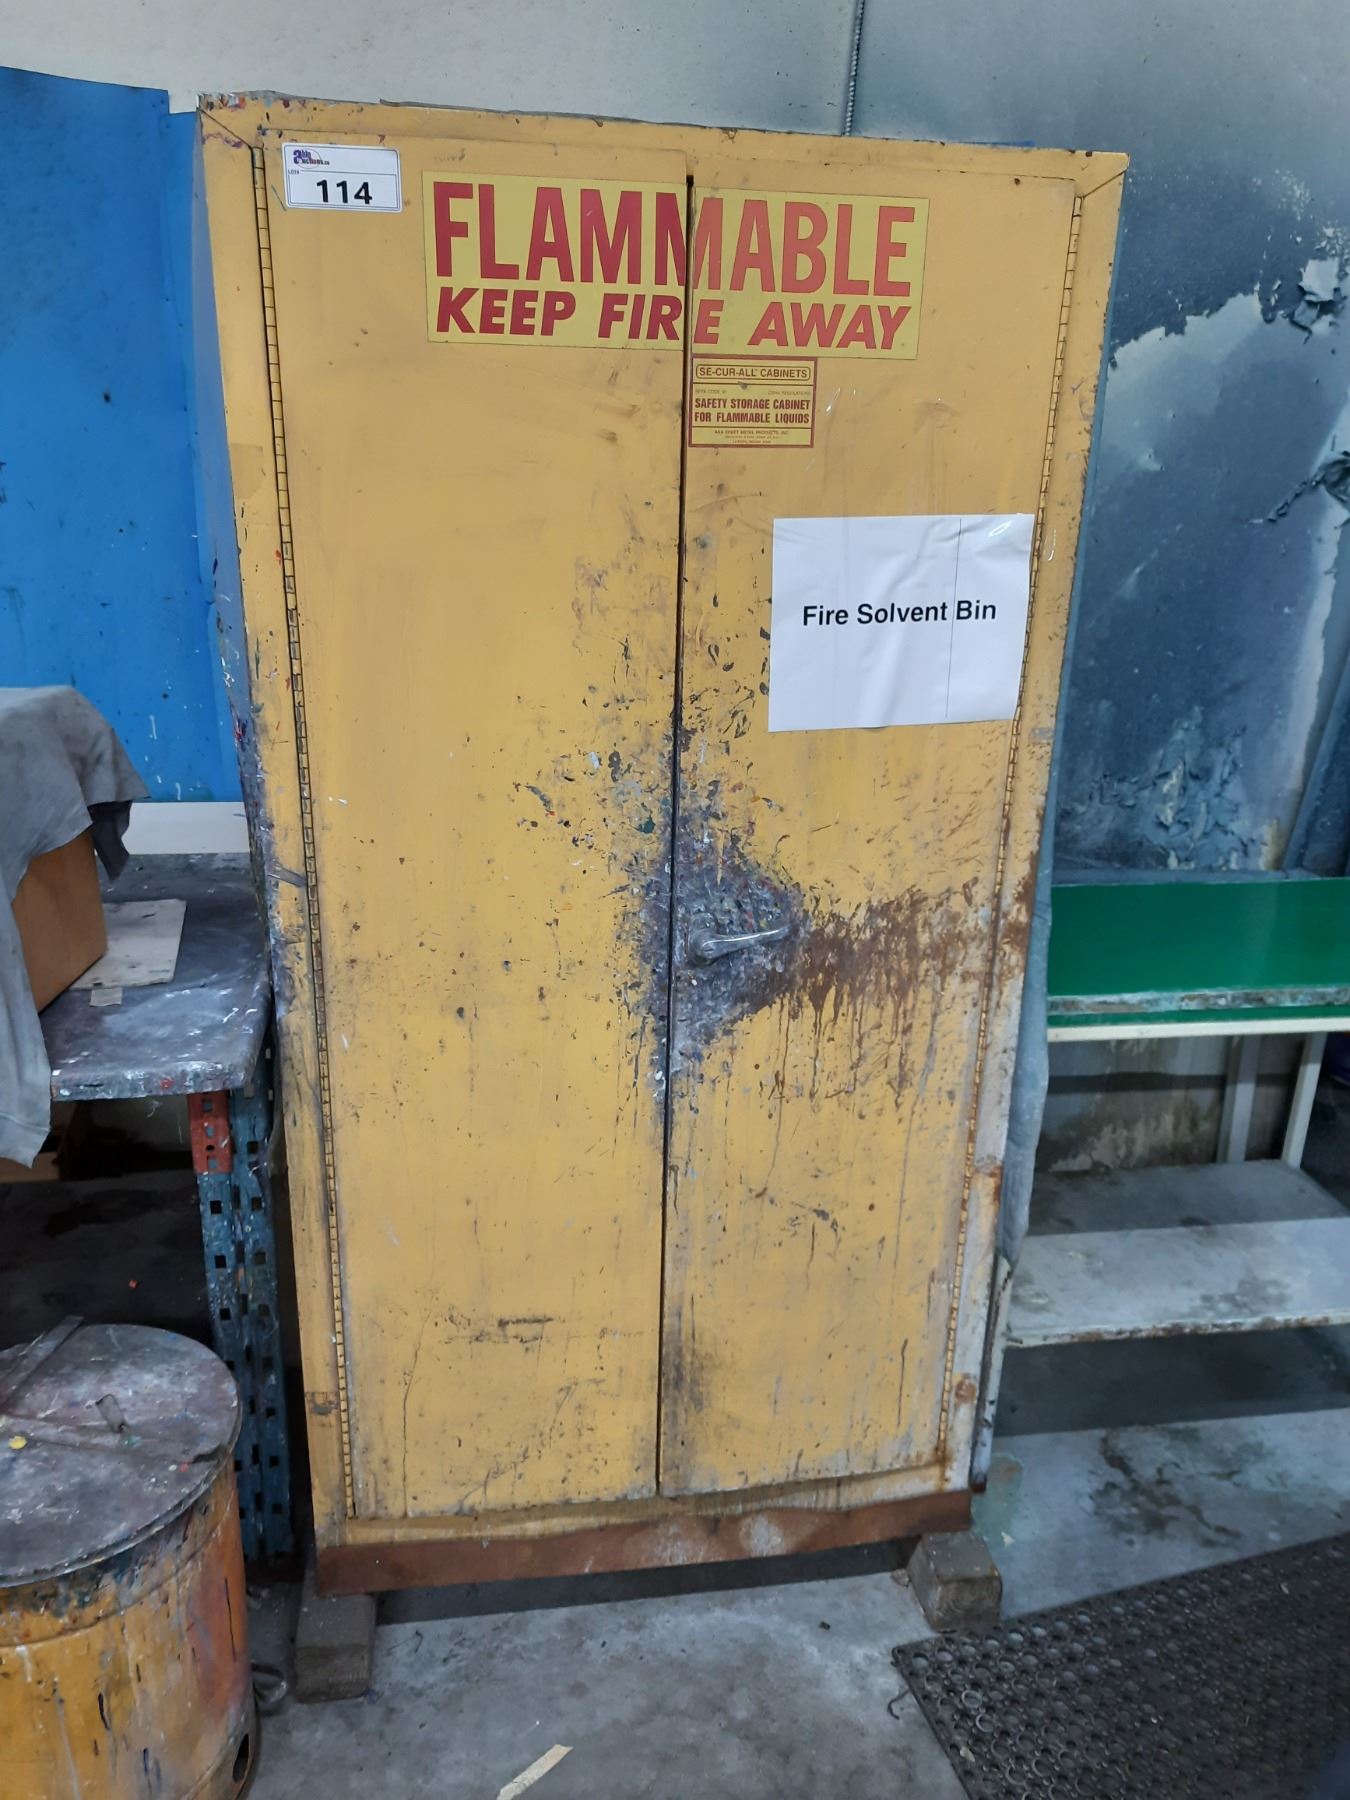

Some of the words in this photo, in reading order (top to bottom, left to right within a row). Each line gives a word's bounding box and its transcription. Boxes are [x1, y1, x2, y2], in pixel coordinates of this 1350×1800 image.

[316, 179, 373, 205] 114
[433, 181, 916, 297] FLAMMABLE
[436, 286, 577, 336] KEEP
[597, 293, 725, 345] FIRE
[747, 302, 912, 350] AWAY
[760, 368, 808, 379] CABINETS
[694, 398, 728, 409] SAFETY
[730, 398, 770, 410] STORAGE
[773, 399, 811, 410] CABINET
[694, 412, 712, 422] FOR
[716, 412, 771, 423] FLAMMABLE
[775, 413, 810, 424] LIQUIDS
[802, 605, 849, 626] Fire
[856, 602, 948, 624] Solvent
[955, 600, 997, 620] Bin
